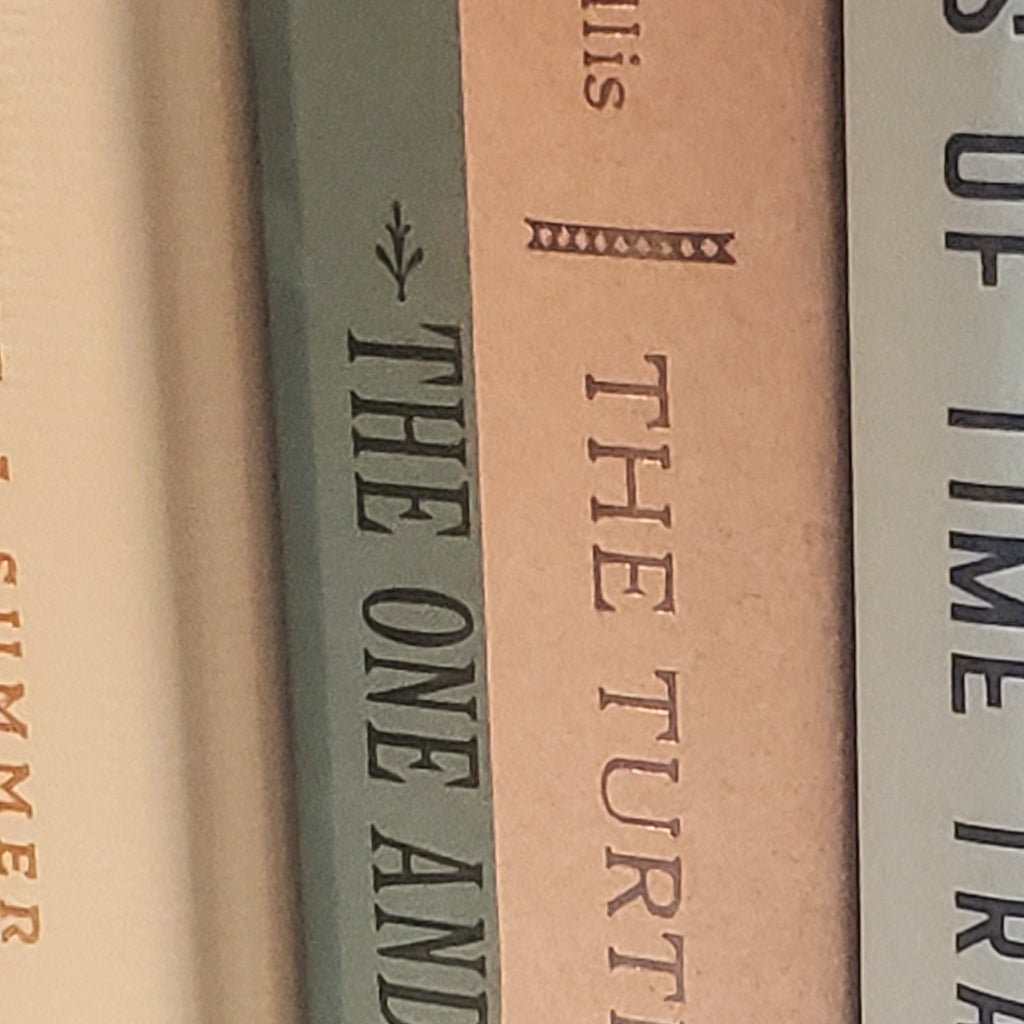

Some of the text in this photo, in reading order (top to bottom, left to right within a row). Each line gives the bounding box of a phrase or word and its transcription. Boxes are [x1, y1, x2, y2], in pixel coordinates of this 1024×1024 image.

[347, 321, 472, 539] THE
[584, 353, 676, 617] THE
[361, 587, 481, 790] ONE
